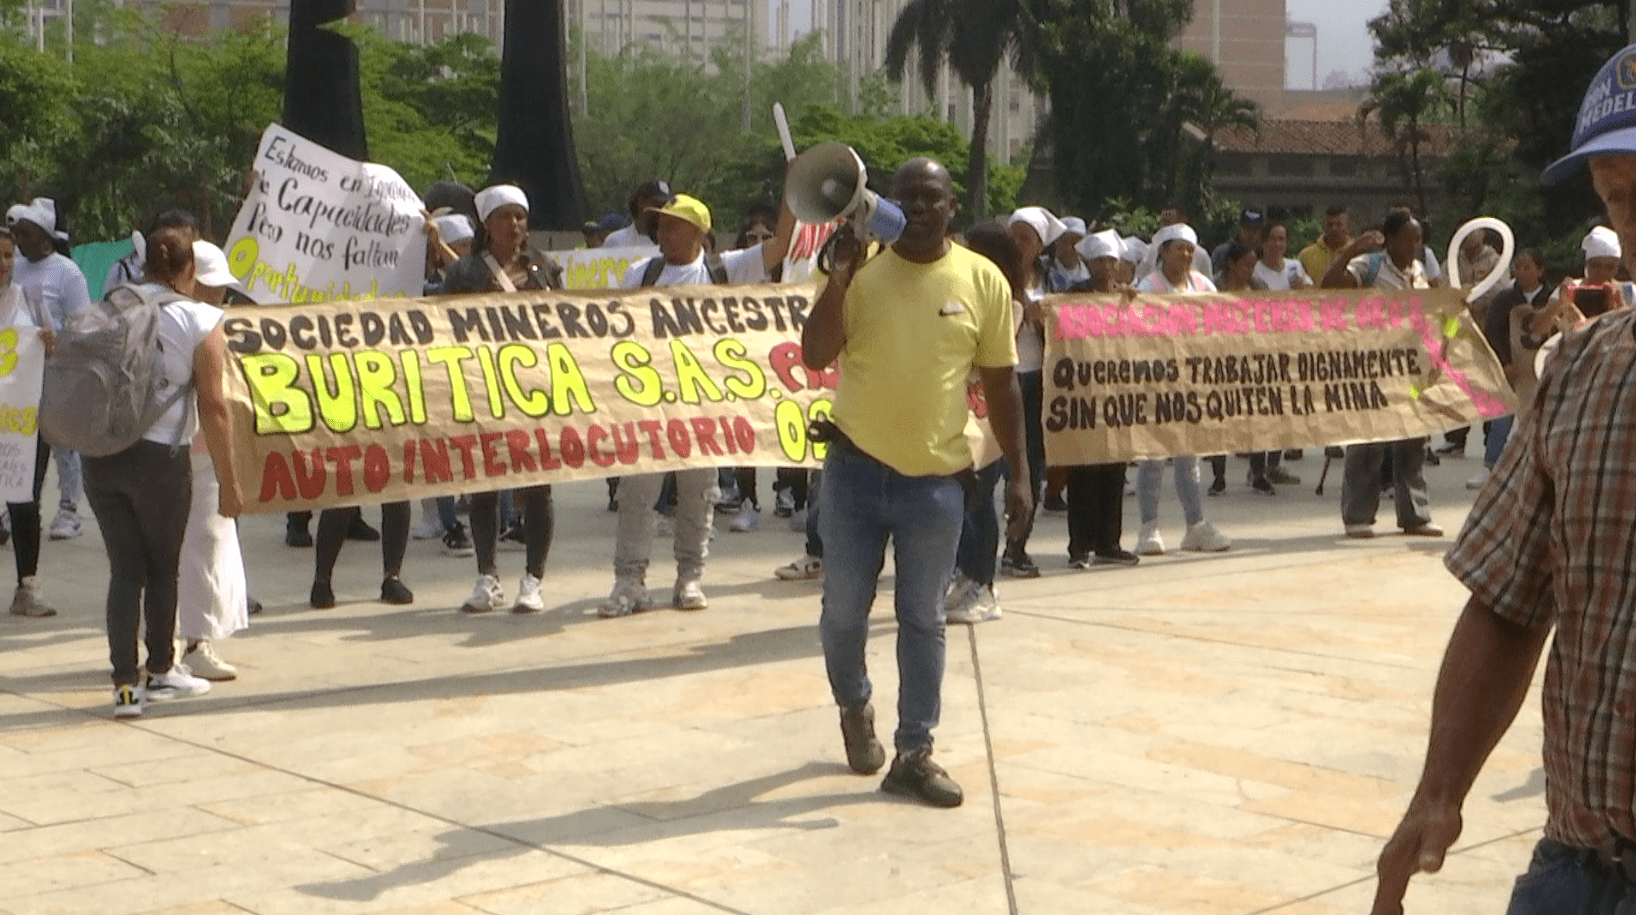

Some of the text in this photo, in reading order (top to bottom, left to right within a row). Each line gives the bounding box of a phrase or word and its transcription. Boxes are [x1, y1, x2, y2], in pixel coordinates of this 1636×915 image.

[1578, 91, 1636, 134] MEDEL
[264, 136, 329, 183] Estamos
[339, 176, 362, 193] en
[247, 202, 284, 243] Pero
[296, 231, 335, 262] nos
[278, 177, 410, 237] Capacidades
[223, 295, 809, 352] SOCIEDAD MINEROS ANCESTR
[239, 342, 597, 436] BURITICA
[611, 338, 783, 406] S.A.S.
[1186, 351, 1291, 385] TRABAJAR
[1298, 349, 1422, 382] DIGNAMENTE
[1046, 381, 1388, 433] SIN QUE NOS QUITEN LA MINA
[259, 443, 391, 502] AUTO
[404, 415, 756, 484] INTERLOCUTORIO
